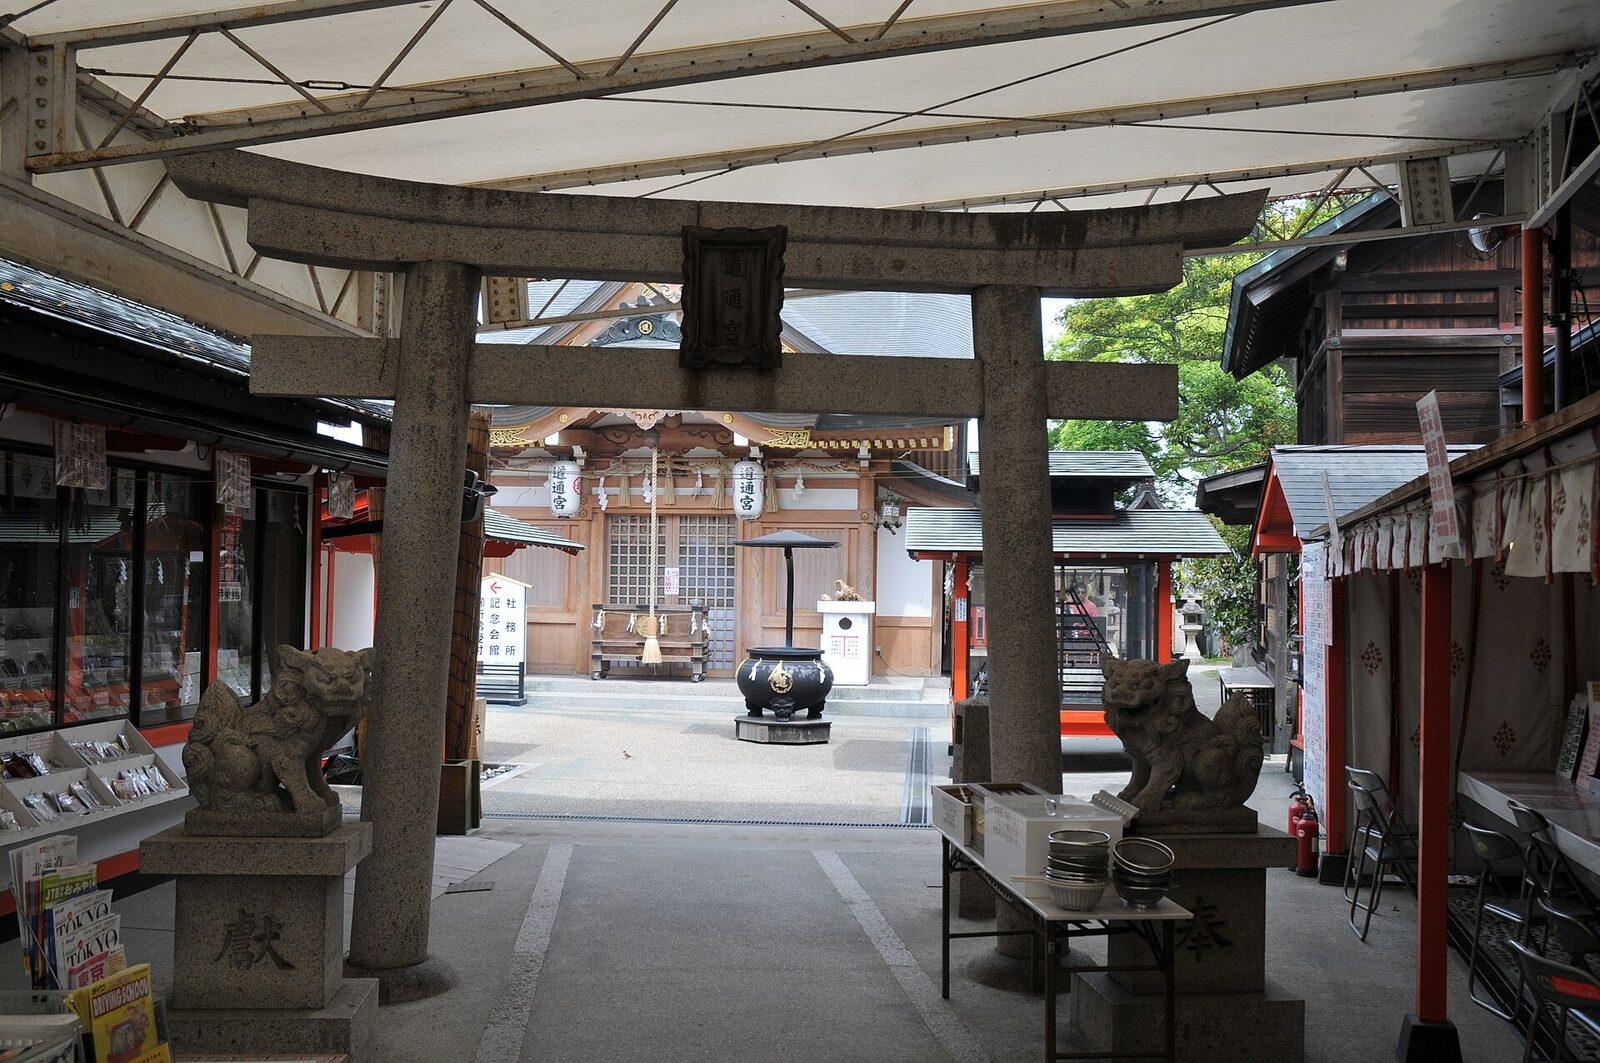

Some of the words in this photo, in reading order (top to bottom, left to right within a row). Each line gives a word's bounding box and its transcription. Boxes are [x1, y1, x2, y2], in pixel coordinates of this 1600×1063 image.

[552, 465, 567, 510] 道通宮
[740, 466, 755, 511] 道通宮
[489, 597, 501, 656] 記念会館
[505, 597, 517, 656] 社務所
[56, 902, 109, 936] TOKYO
[1176, 896, 1235, 962] 奉
[66, 928, 118, 967] TOKYO
[78, 962, 105, 988] 東京
[92, 986, 124, 1018] DRIVING
[122, 976, 149, 1008] SCHOOL
